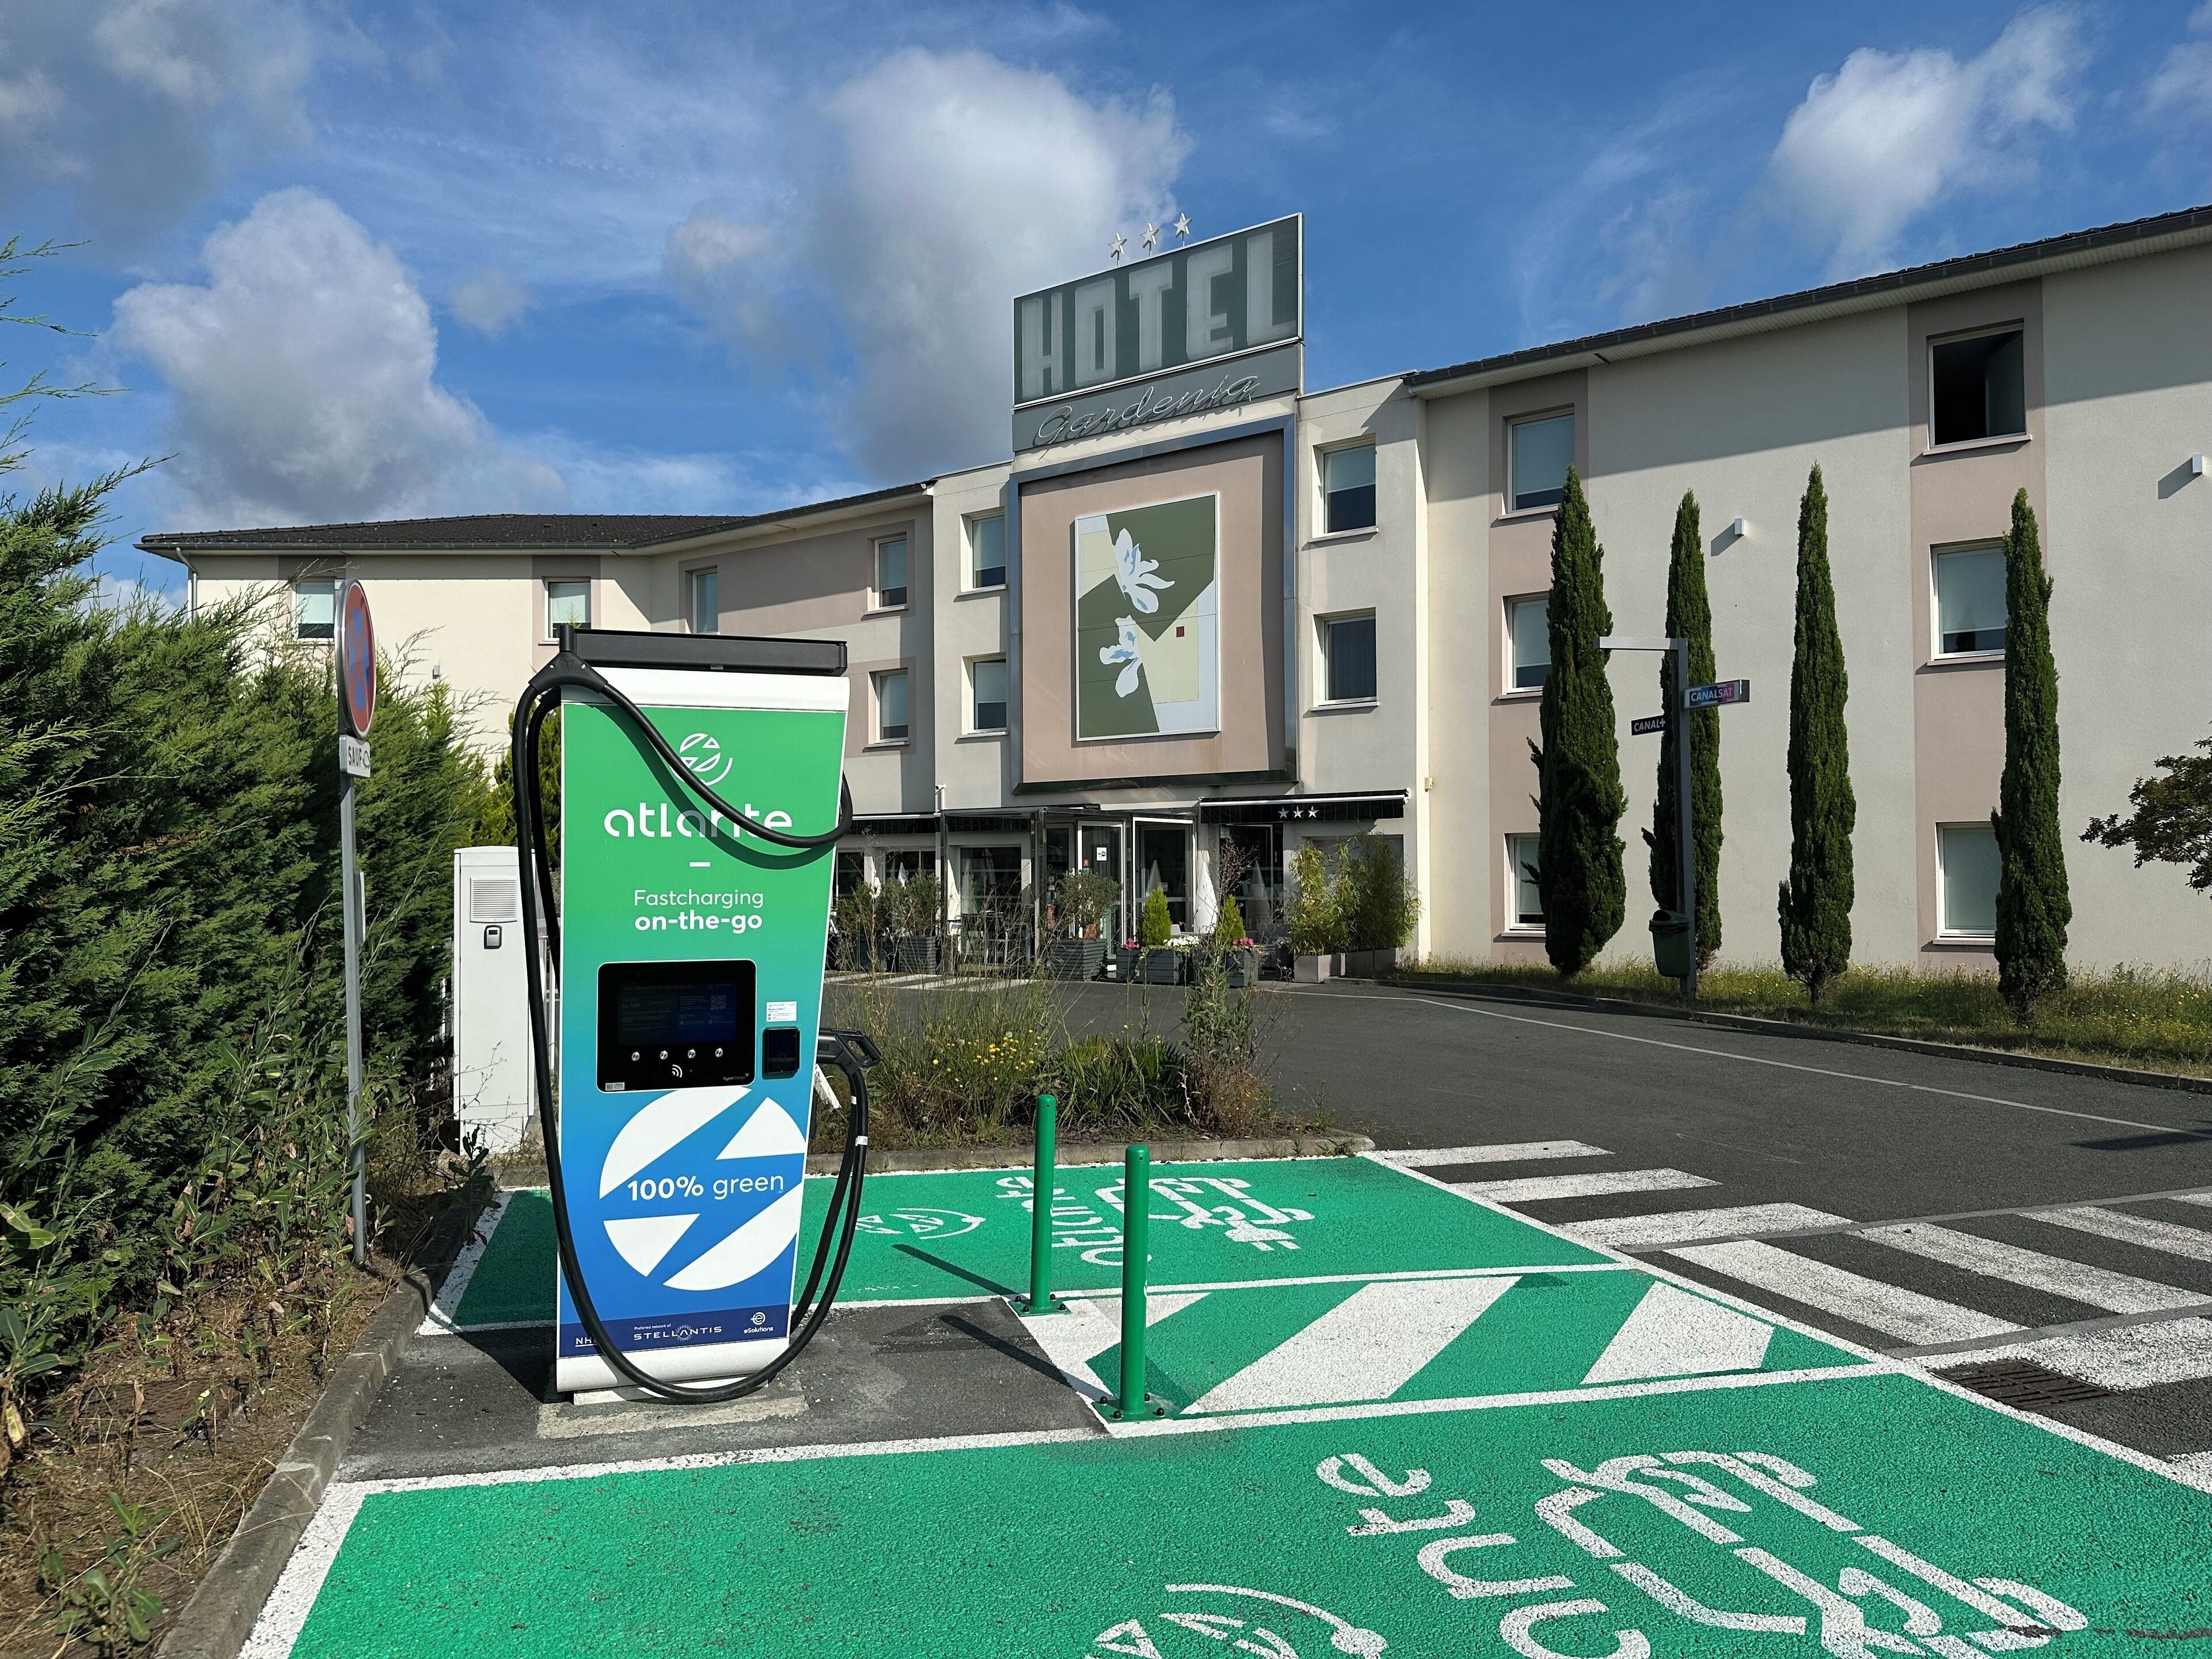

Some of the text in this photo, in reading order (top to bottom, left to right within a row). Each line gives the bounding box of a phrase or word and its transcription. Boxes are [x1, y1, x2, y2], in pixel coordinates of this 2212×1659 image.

[1021, 232, 1297, 400] HOTEL
[1038, 374, 1260, 442] Gardenia
[1691, 687, 1733, 702] CANALSAT
[1634, 718, 1665, 732] CANAL+
[348, 745, 362, 768] SAUF
[634, 889, 763, 909] Fastcharging
[635, 910, 763, 934] on-the-go
[627, 1175, 784, 1200] 100% green
[634, 1326, 722, 1340] STELLANTIS
